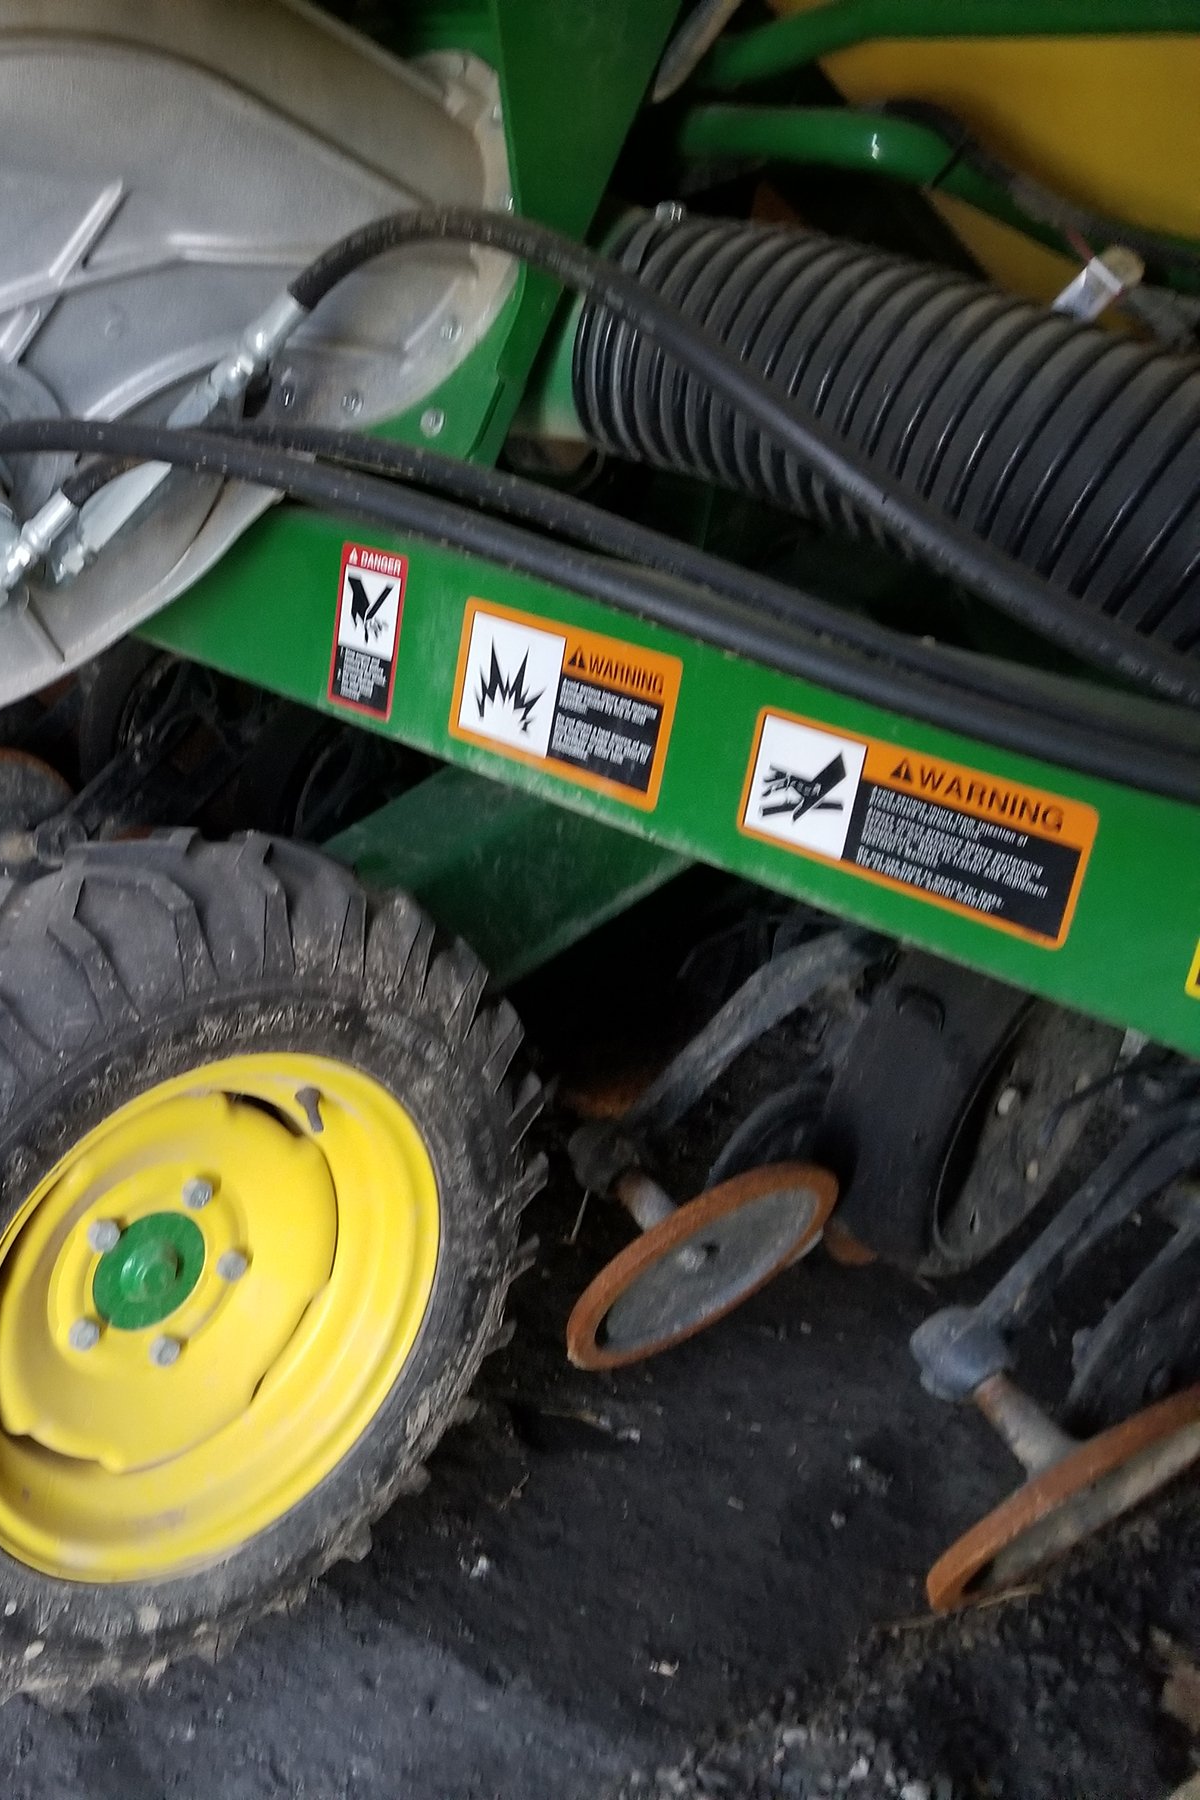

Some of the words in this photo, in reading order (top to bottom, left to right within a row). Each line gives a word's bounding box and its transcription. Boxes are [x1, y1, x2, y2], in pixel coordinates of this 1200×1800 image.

[360, 551, 402, 577] DANGER
[588, 653, 665, 696] WARNING
[919, 767, 1064, 833] WARNING
